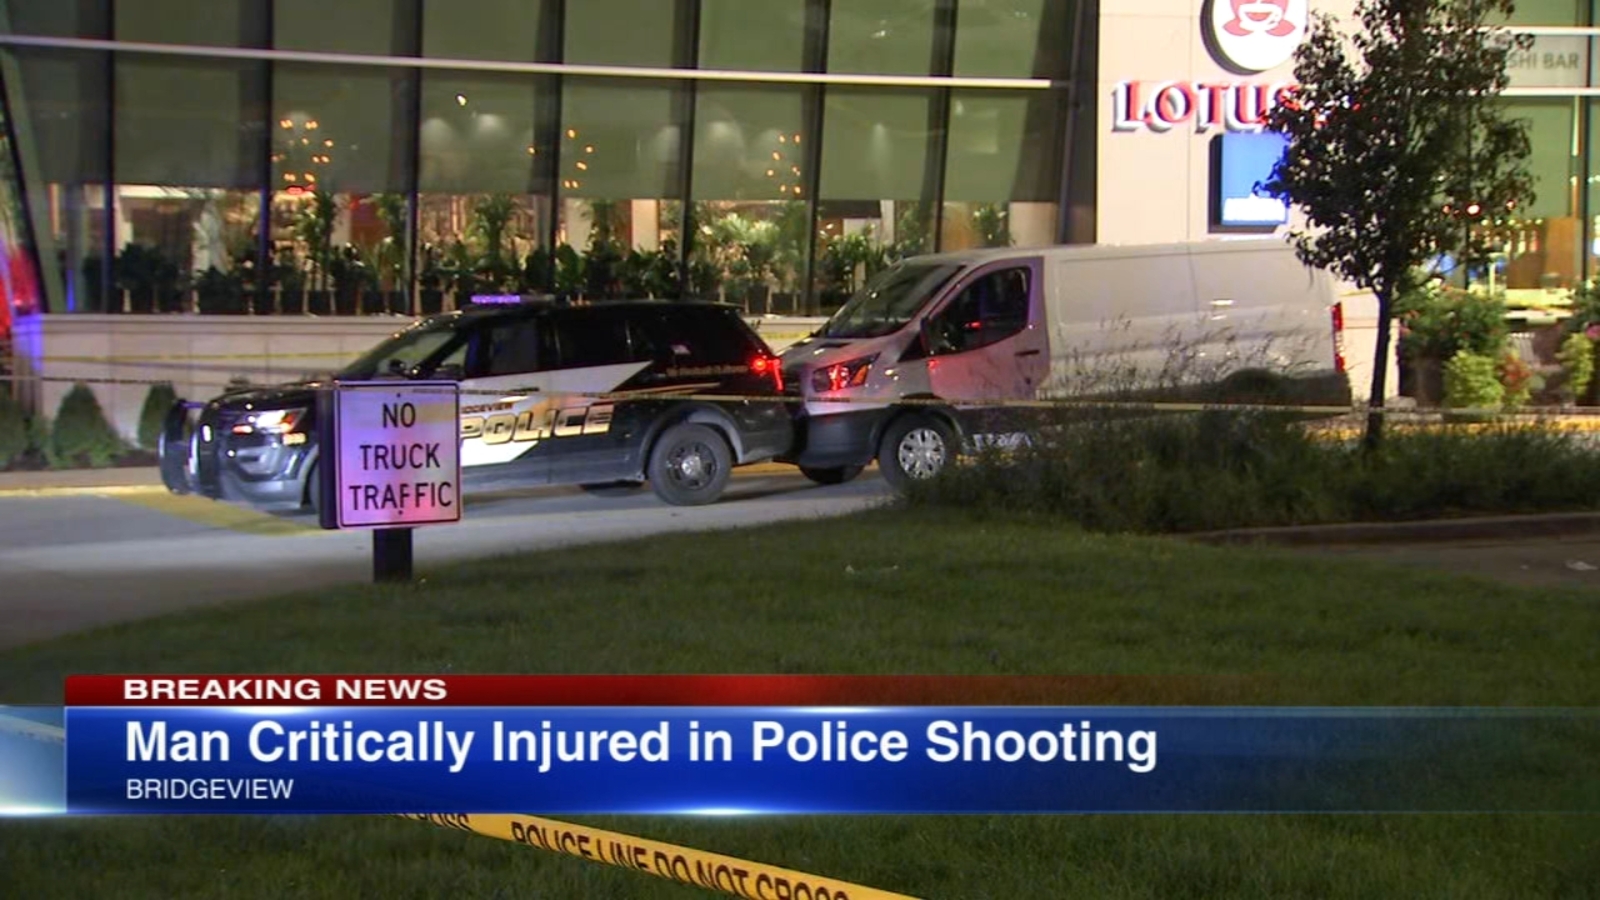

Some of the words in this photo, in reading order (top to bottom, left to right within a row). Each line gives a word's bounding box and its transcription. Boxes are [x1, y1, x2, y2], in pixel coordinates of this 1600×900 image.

[1543, 52, 1579, 69] BAR
[382, 402, 416, 427] NO
[461, 402, 615, 445] POLICE
[359, 443, 440, 470] TRUCK
[349, 482, 452, 510] TRAFFIC
[511, 821, 591, 858] POLICE
[596, 840, 648, 870] LINE
[654, 852, 690, 882] DO
[697, 860, 748, 898] NOT
[756, 873, 849, 900] CRO
